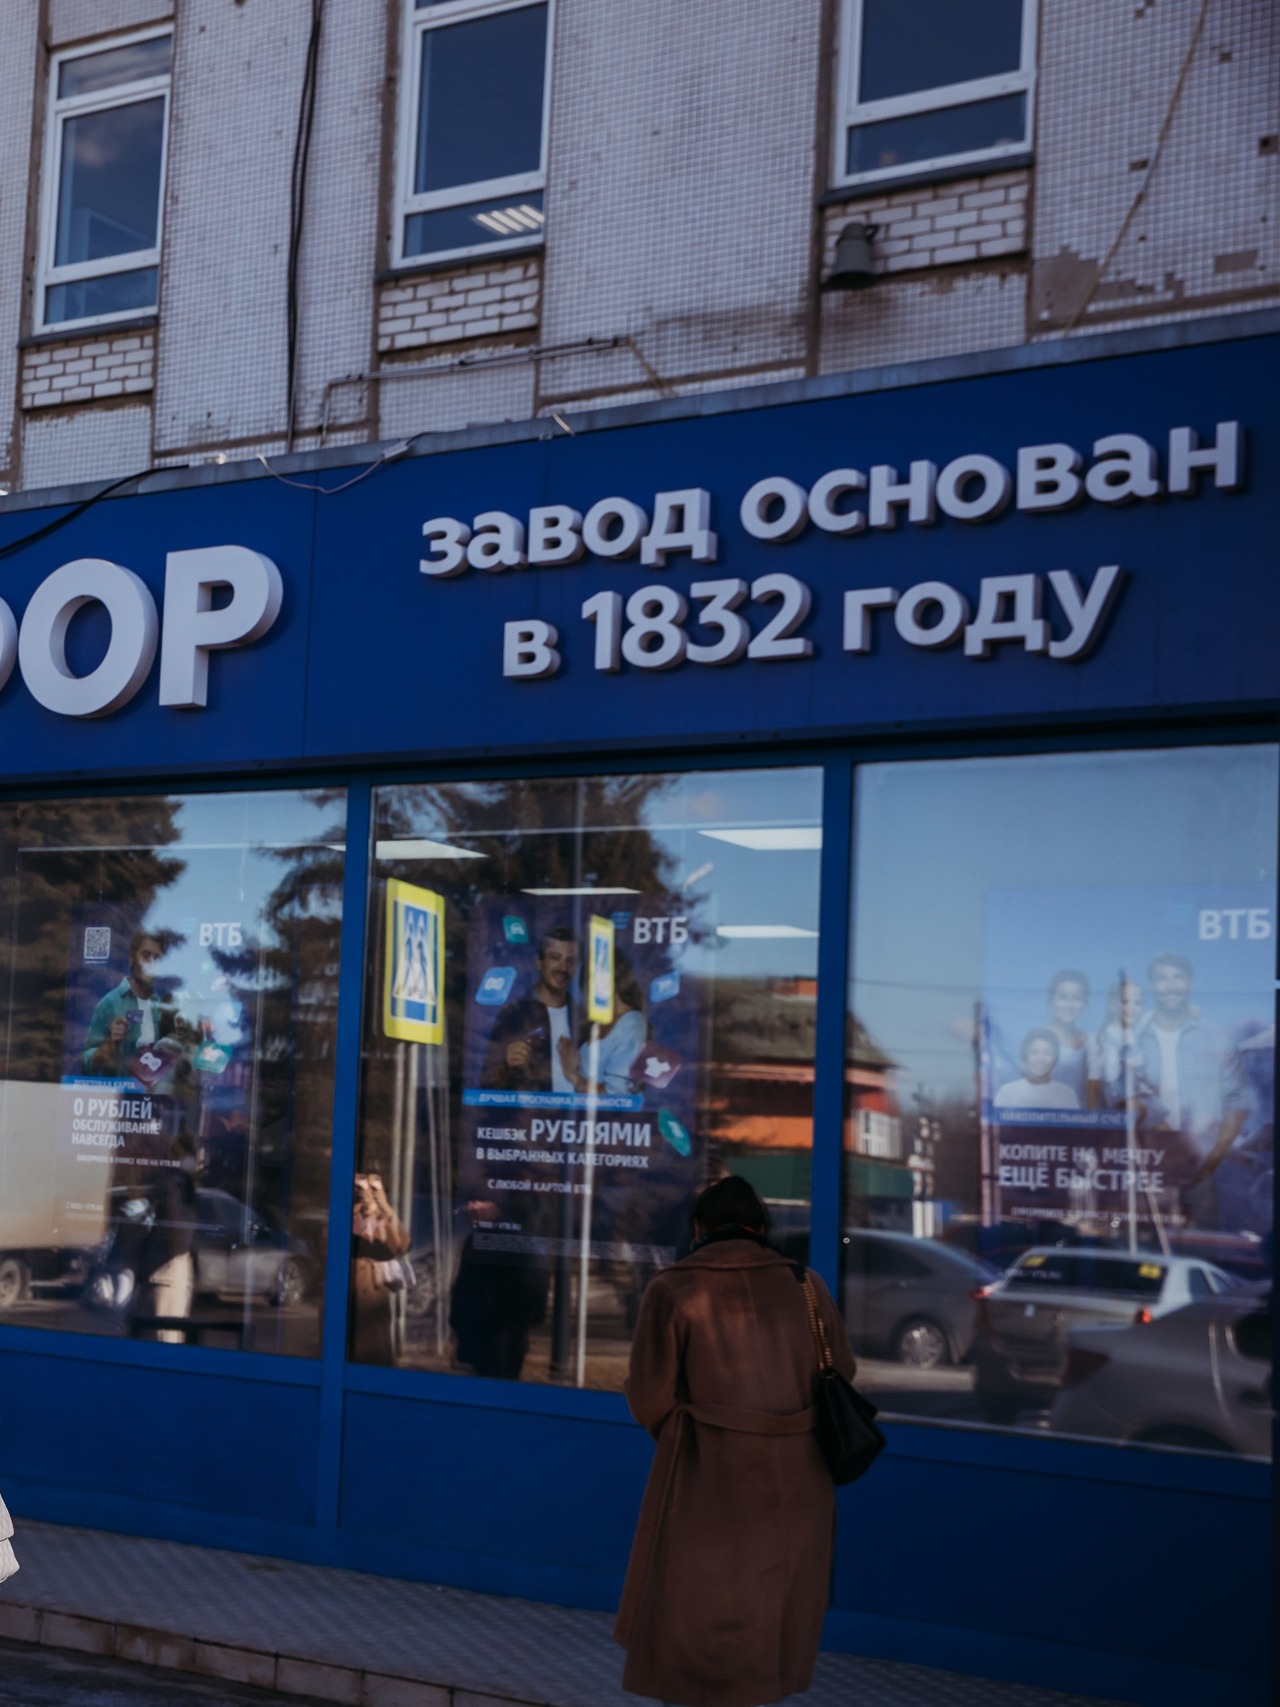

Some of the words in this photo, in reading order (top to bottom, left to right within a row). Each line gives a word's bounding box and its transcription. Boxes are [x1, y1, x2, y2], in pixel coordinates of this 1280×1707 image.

[419, 486, 718, 578] завод
[740, 420, 1244, 543] основан
[503, 618, 562, 679] в
[581, 573, 814, 673] 1832
[843, 564, 1121, 660] году
[199, 922, 243, 947] ВТБ
[633, 916, 689, 945] ВТБ
[1199, 908, 1272, 940] ВТБ
[87, 1096, 153, 1120] РУБЛЕЙ
[72, 1119, 160, 1135] ОБСЛУЖИВАНИЕ
[477, 1127, 528, 1142] КЕШБЭК
[530, 1118, 652, 1148] РУБЛЯМИ
[71, 1132, 126, 1149] НАВСЕГДА
[476, 1148, 485, 1160] В
[487, 1148, 565, 1164] ВЫБРАННЫХ
[567, 1152, 650, 1169] КАТЕГОРИЯХ
[999, 1143, 1068, 1162] КОПИТЕ
[1072, 1146, 1098, 1163] НА
[1102, 1147, 1166, 1166] МЕЧТУ
[495, 1178, 532, 1191] ЛЮБОЙ
[533, 1180, 571, 1194] КАРТОЙ
[998, 1163, 1050, 1191] ЕЩЁ
[1055, 1167, 1165, 1194] БЫСТРЕЕ
